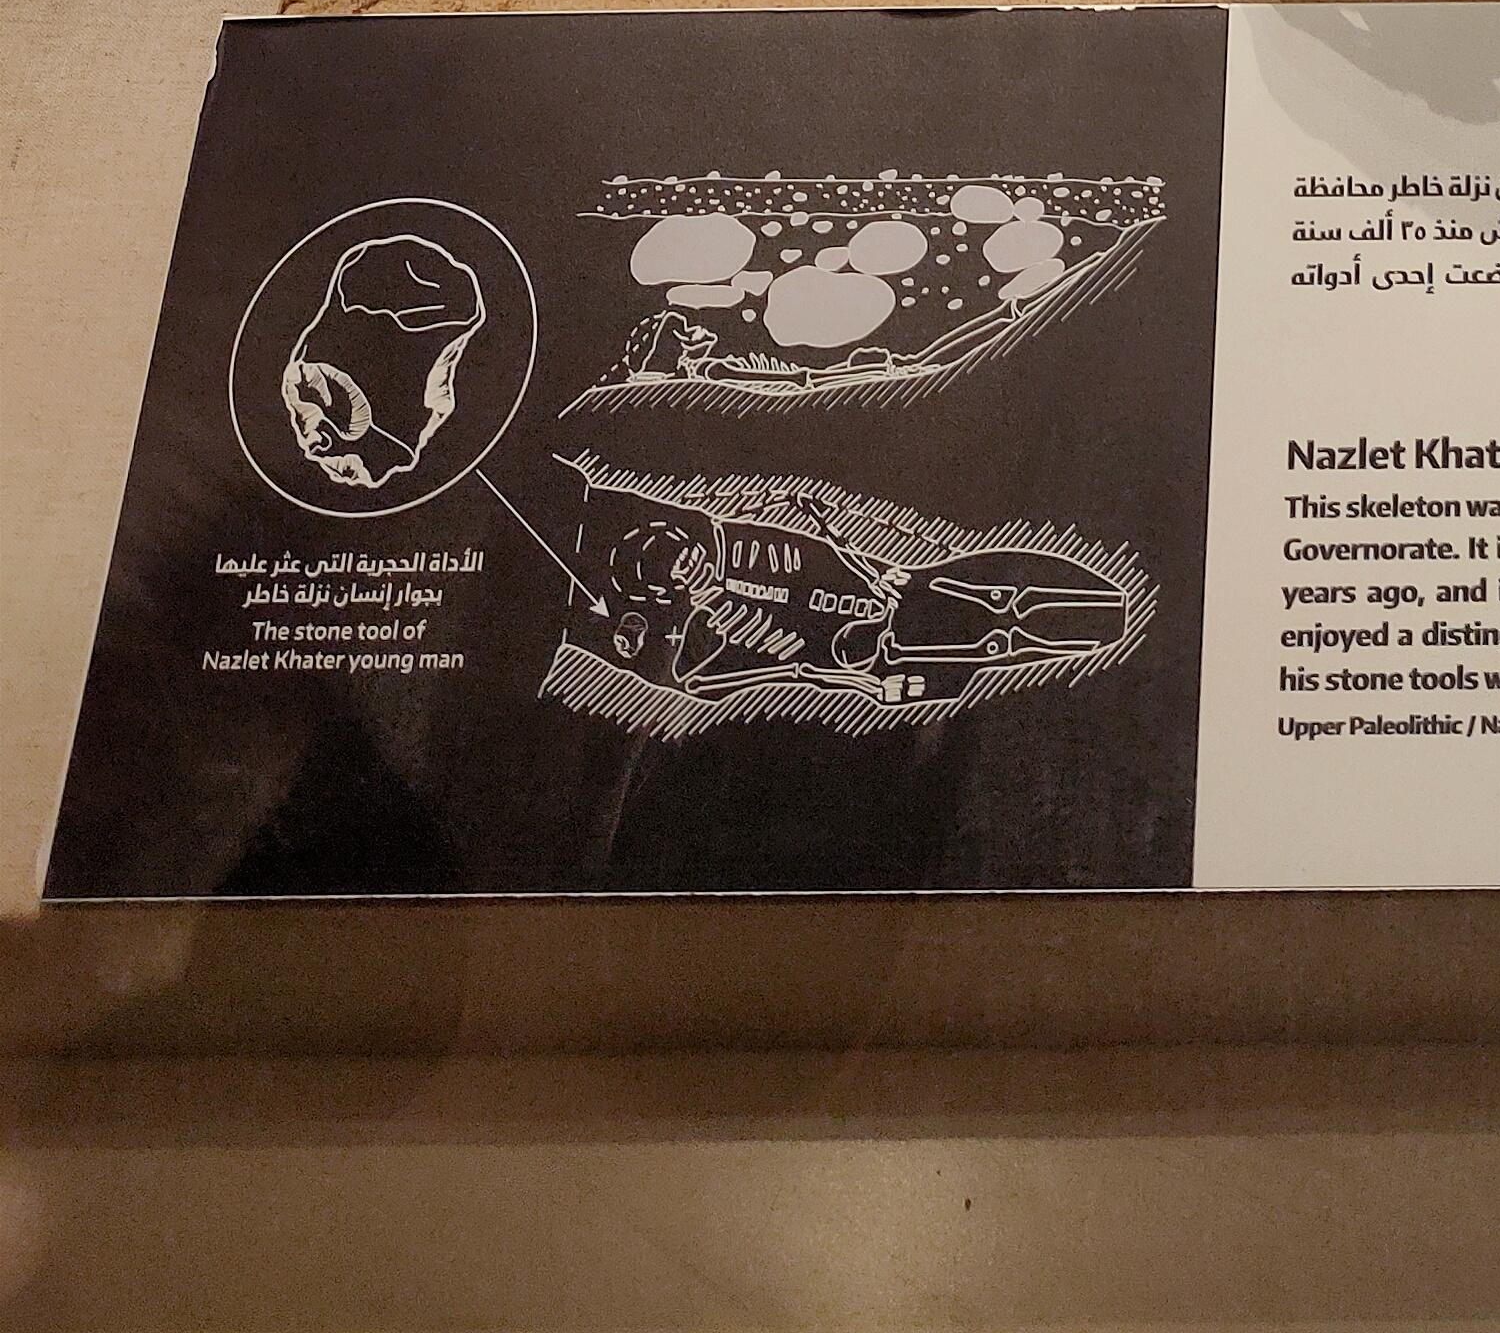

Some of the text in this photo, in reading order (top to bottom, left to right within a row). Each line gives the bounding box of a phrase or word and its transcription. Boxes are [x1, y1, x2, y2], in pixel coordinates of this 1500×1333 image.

[1294, 175, 1383, 197] محافظة
[1388, 175, 1443, 202] خاطر
[1449, 175, 1490, 202] نزلة
[1292, 220, 1341, 241] سنة
[1349, 209, 1393, 240] ألف
[1401, 221, 1426, 240] ٣٥
[1433, 219, 1473, 240] منذ
[1291, 253, 1361, 291] أدواته
[1288, 437, 1406, 470] Nazlet
[1284, 494, 1340, 518] This
[1346, 493, 1461, 518] skeleton
[429, 547, 483, 572] الأداة
[1284, 538, 1460, 561] Governorate.
[1469, 537, 1489, 559] It
[215, 553, 267, 577] عليها
[270, 550, 301, 578] عثر
[356, 552, 426, 577] الحجرية
[242, 582, 443, 612] بجوار إنسان نزلة خاطر
[1281, 586, 1356, 610] years
[1367, 585, 1425, 609] ago,
[1436, 577, 1487, 603] and
[252, 619, 427, 641] The stone tool of
[1281, 621, 1389, 653] enjoyed
[1397, 629, 1413, 646] a
[202, 648, 464, 674] Nazlet Khater young man
[1280, 666, 1319, 691] his
[1324, 668, 1404, 691] stone
[1408, 664, 1479, 690] tools
[1278, 717, 1346, 741] Upper
[1349, 714, 1463, 735] Paleolithic
